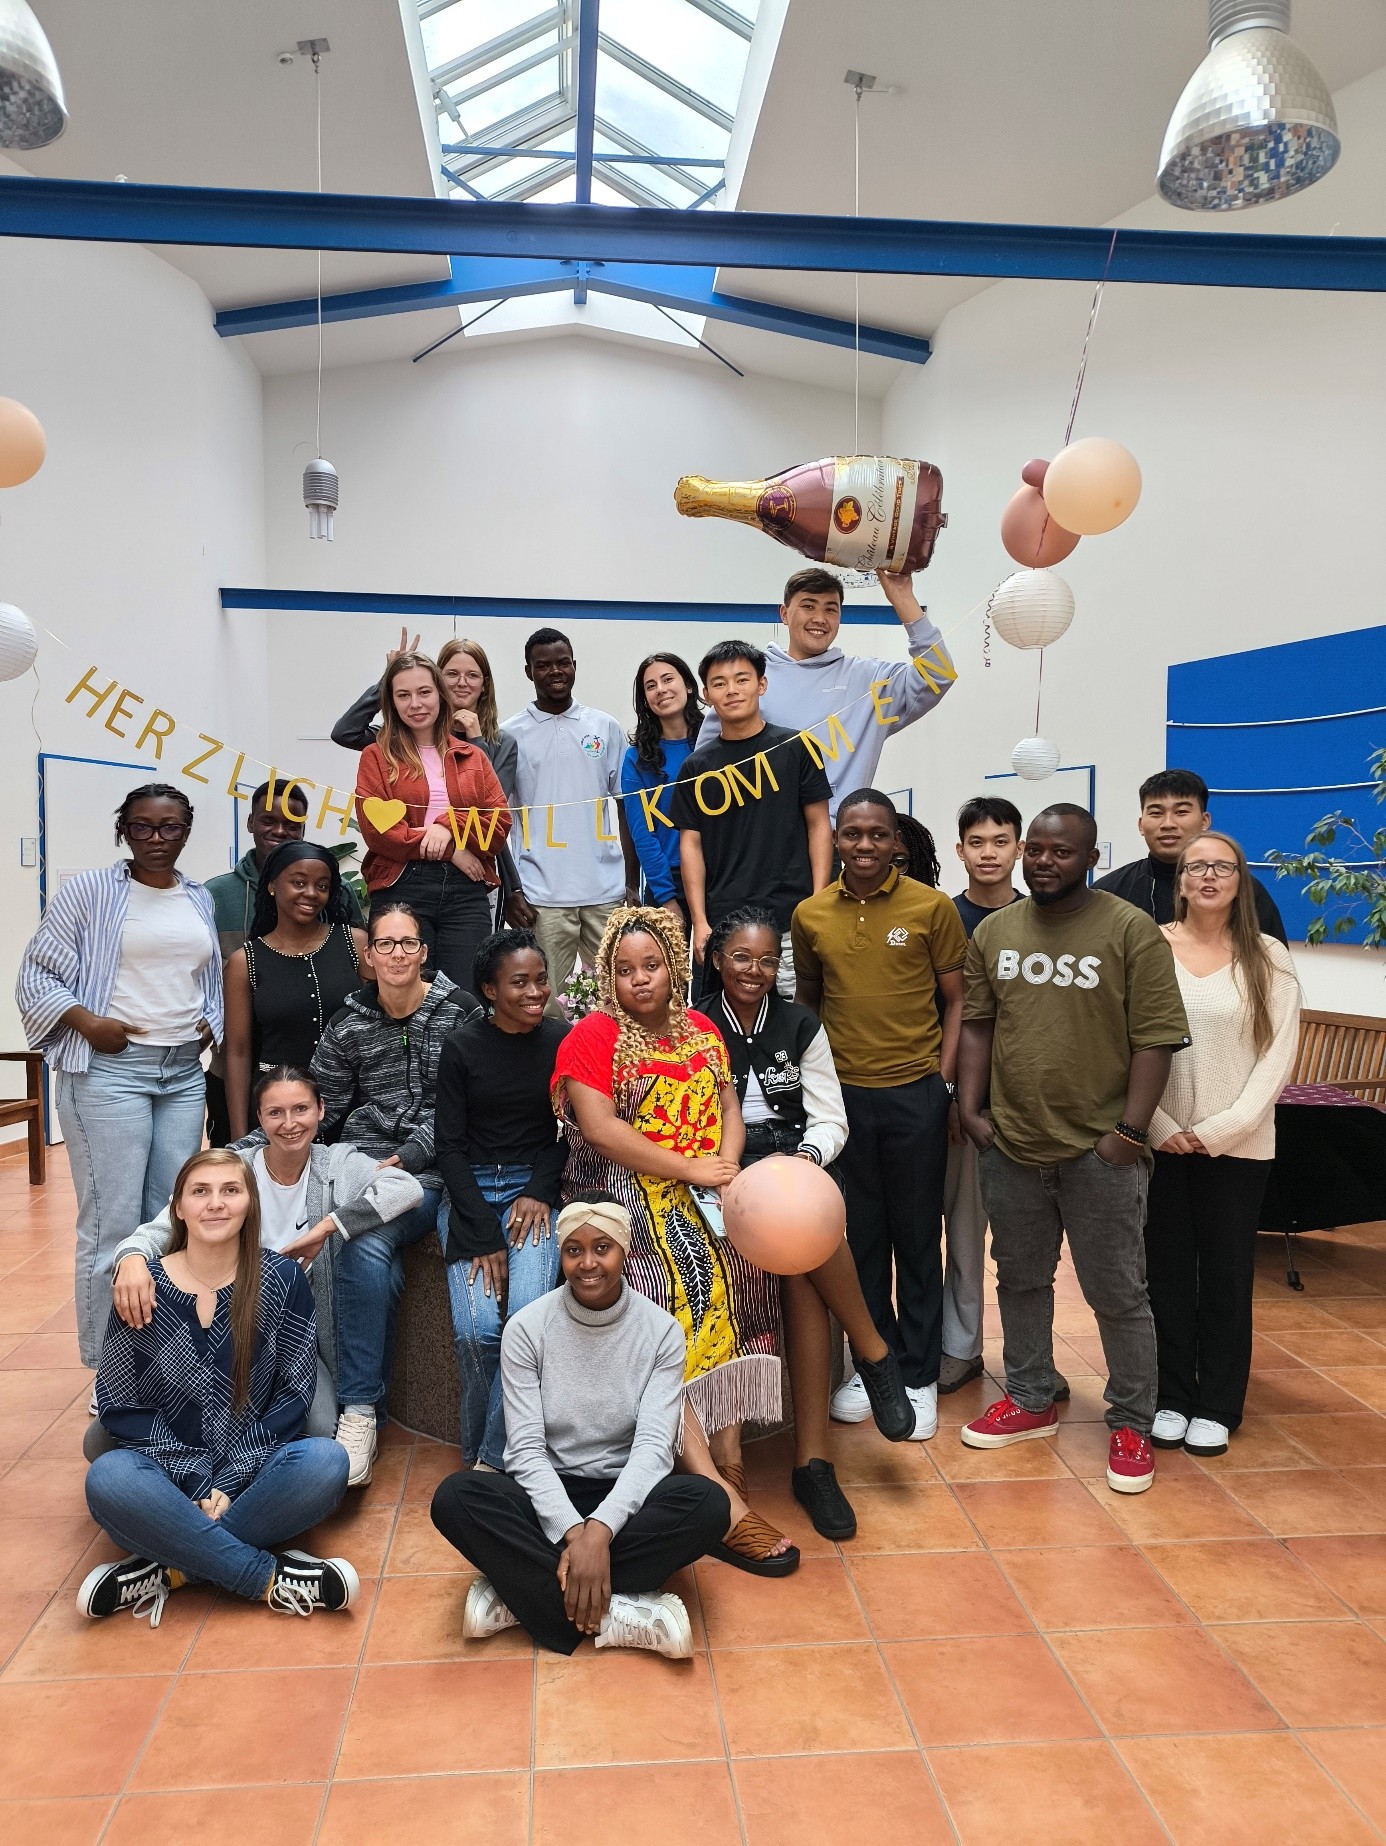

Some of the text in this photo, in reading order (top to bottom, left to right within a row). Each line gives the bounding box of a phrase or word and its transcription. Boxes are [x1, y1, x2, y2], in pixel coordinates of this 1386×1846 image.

[854, 527, 880, 570] Château
[890, 518, 899, 544] VINTAGE
[65, 644, 958, 852] HERZLICH WILLKOMMEN
[997, 949, 1102, 989] BOSS
[775, 1050, 788, 1063] 23
